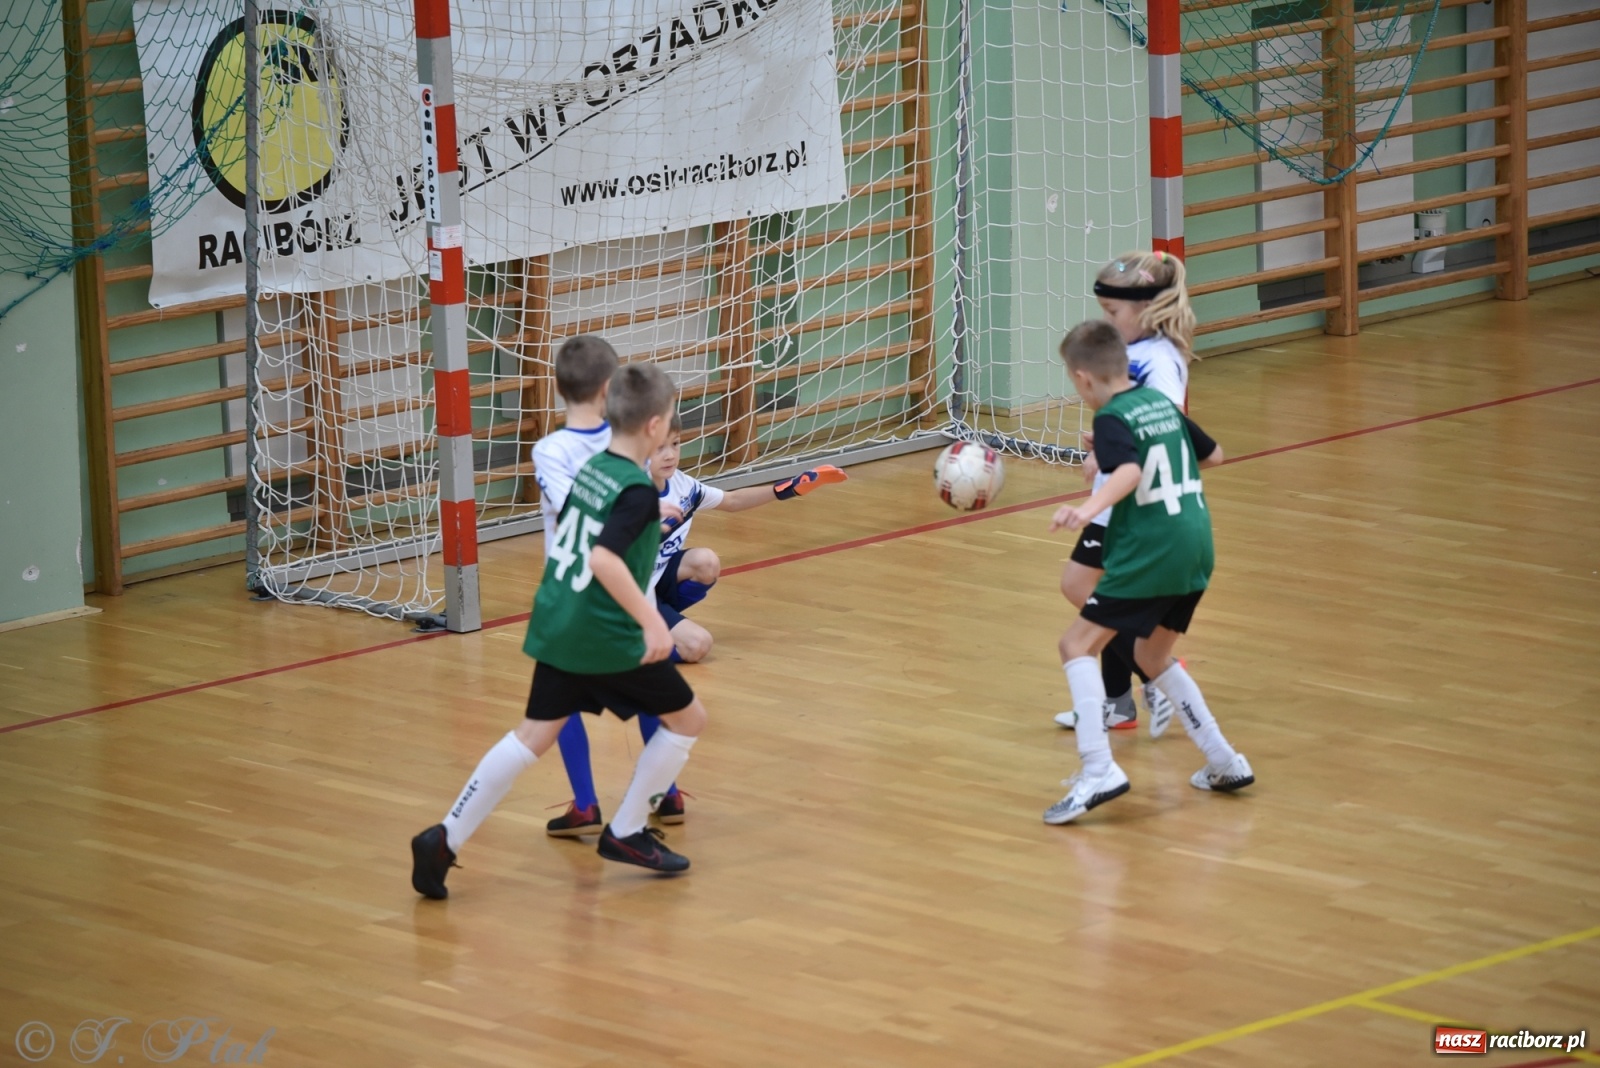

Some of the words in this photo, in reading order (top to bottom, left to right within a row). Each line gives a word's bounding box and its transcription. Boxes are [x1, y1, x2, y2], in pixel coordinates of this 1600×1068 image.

[560, 140, 808, 206] www.osir-raciborz.pl
[198, 210, 362, 270] RAIBÓRZ
[549, 505, 605, 593] 45
